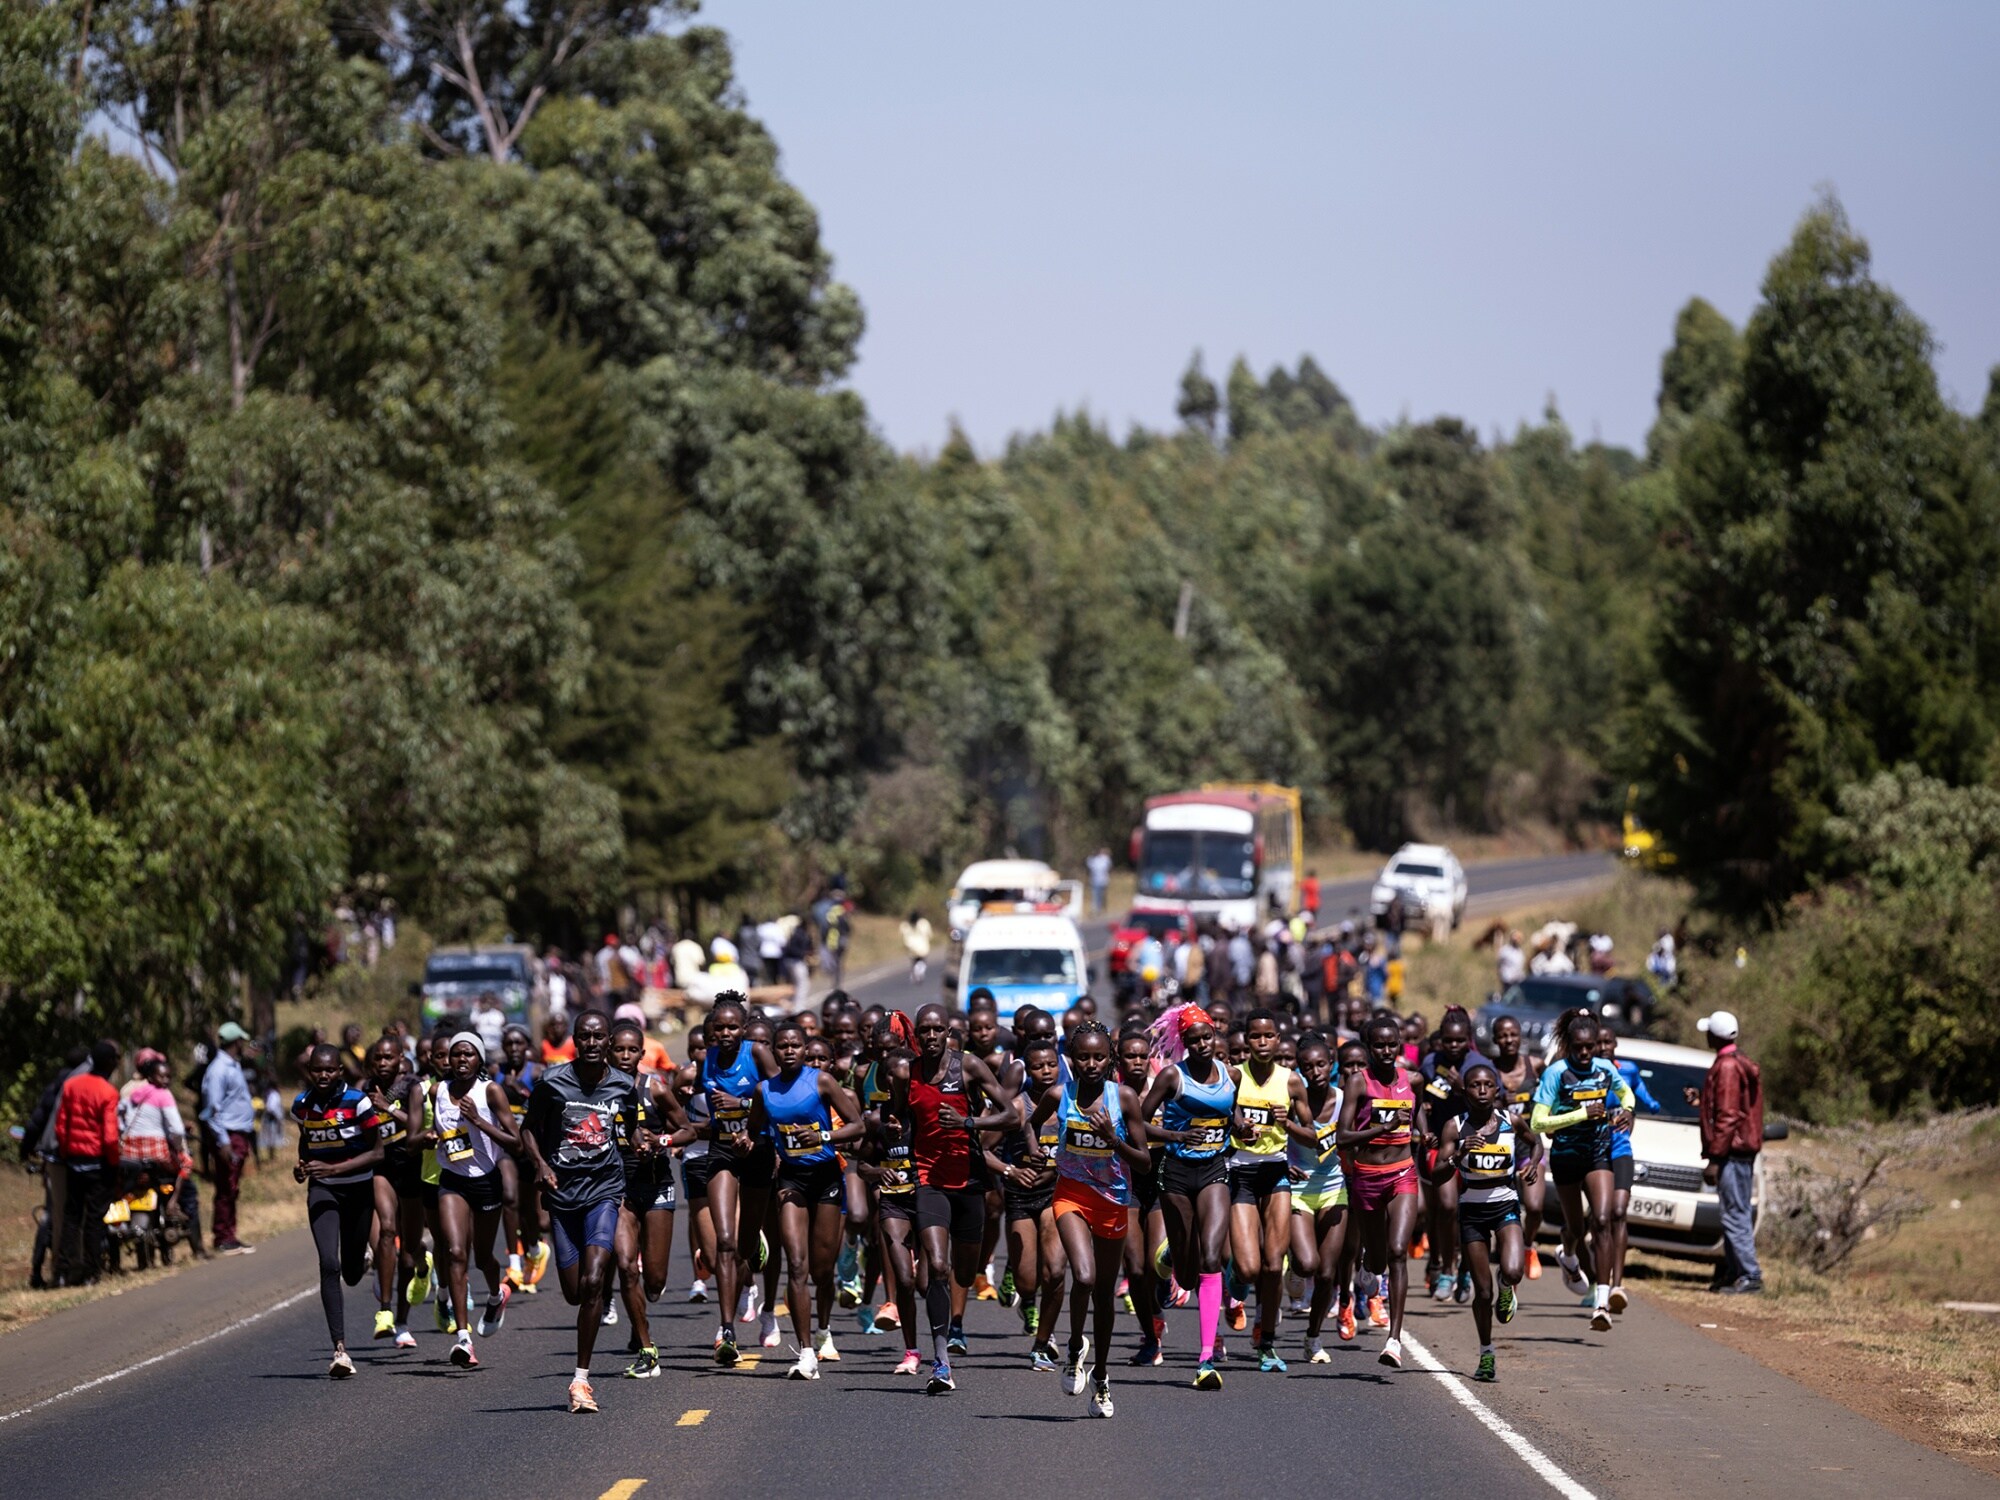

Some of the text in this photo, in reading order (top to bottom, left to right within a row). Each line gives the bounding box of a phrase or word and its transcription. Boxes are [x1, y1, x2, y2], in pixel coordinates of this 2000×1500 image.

[309, 1129, 338, 1142] 276
[445, 1138, 466, 1154] 28
[1475, 1154, 1505, 1169] 107
[1633, 1200, 1674, 1216] 890W
